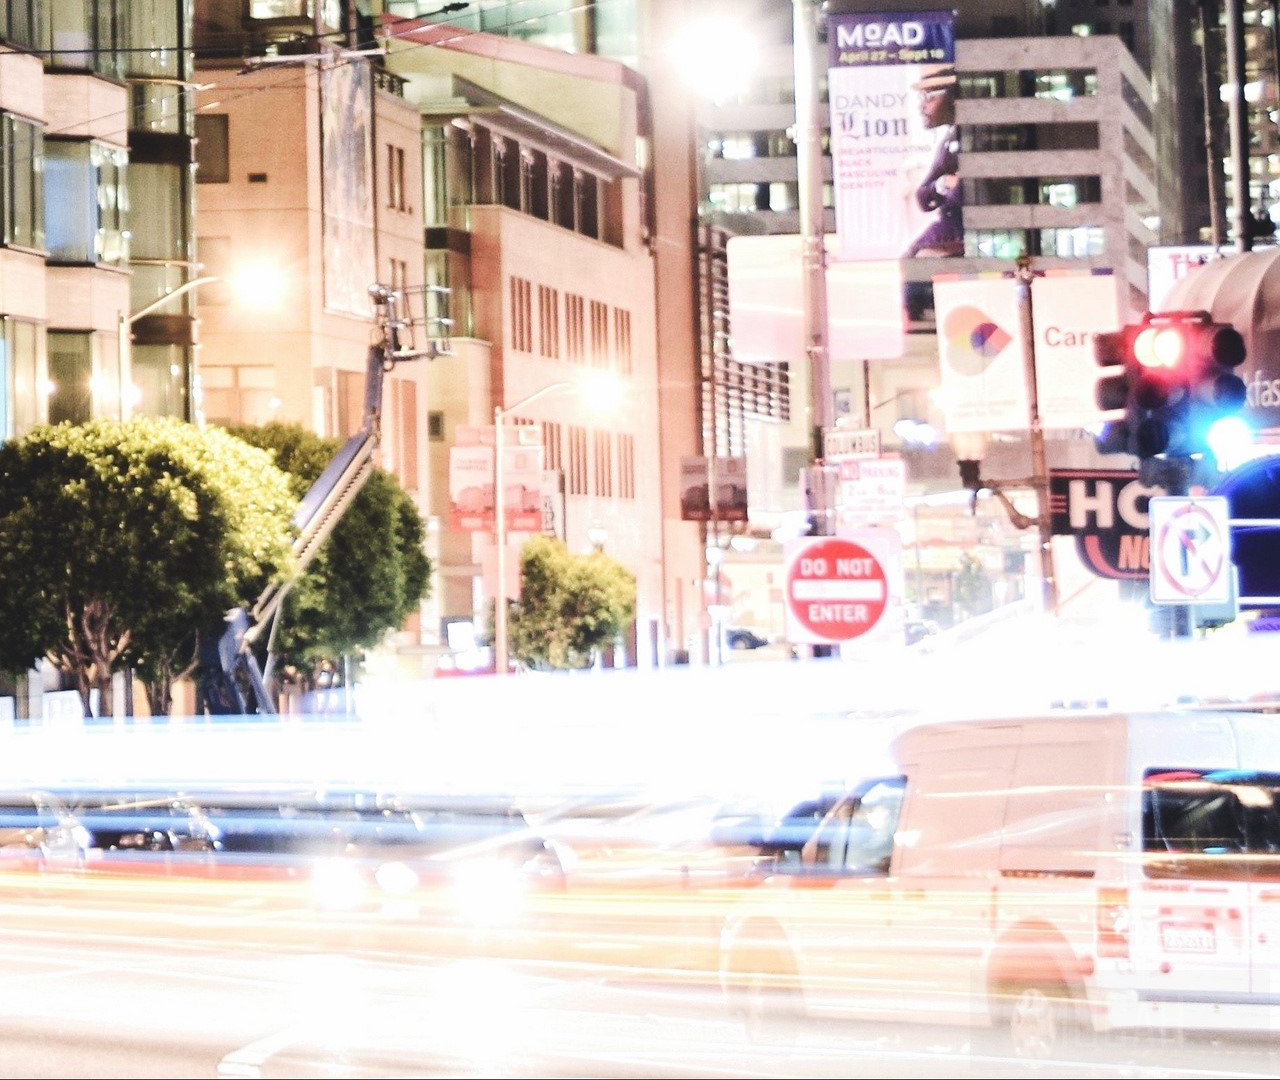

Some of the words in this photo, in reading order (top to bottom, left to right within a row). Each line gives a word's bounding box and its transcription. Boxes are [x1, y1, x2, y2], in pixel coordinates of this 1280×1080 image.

[835, 93, 908, 110] DANDY
[837, 111, 908, 140] Lion
[1045, 326, 1094, 347] Car
[800, 558, 828, 577] DO
[836, 558, 873, 578] NOT
[808, 604, 868, 623] ENTER
